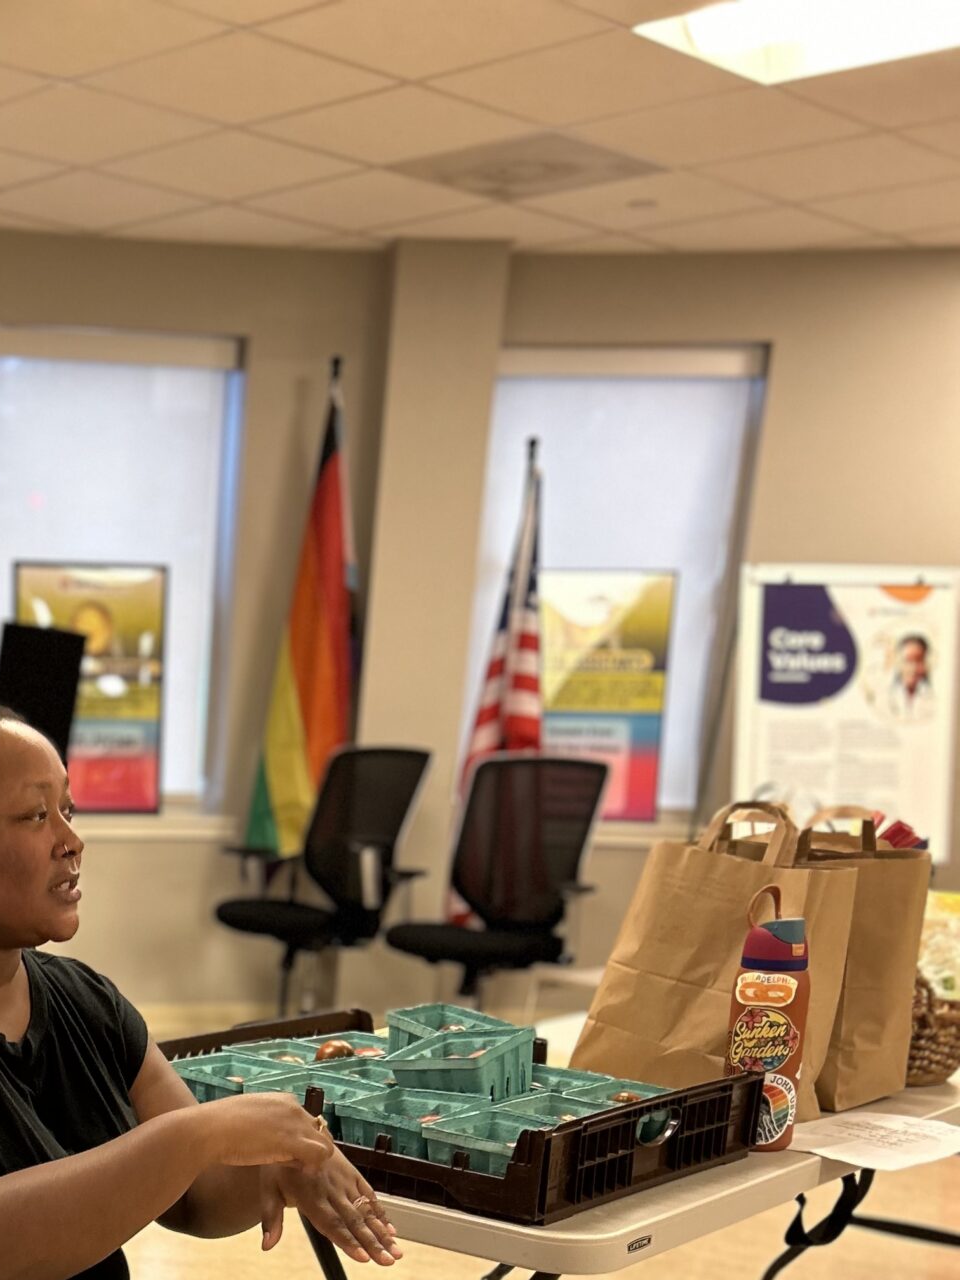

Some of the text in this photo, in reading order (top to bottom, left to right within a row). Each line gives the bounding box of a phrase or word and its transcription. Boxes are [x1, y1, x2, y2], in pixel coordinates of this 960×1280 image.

[735, 1020, 787, 1041] Sunken
[732, 1041, 790, 1063] Gardens
[770, 1075, 794, 1095] JOHN
